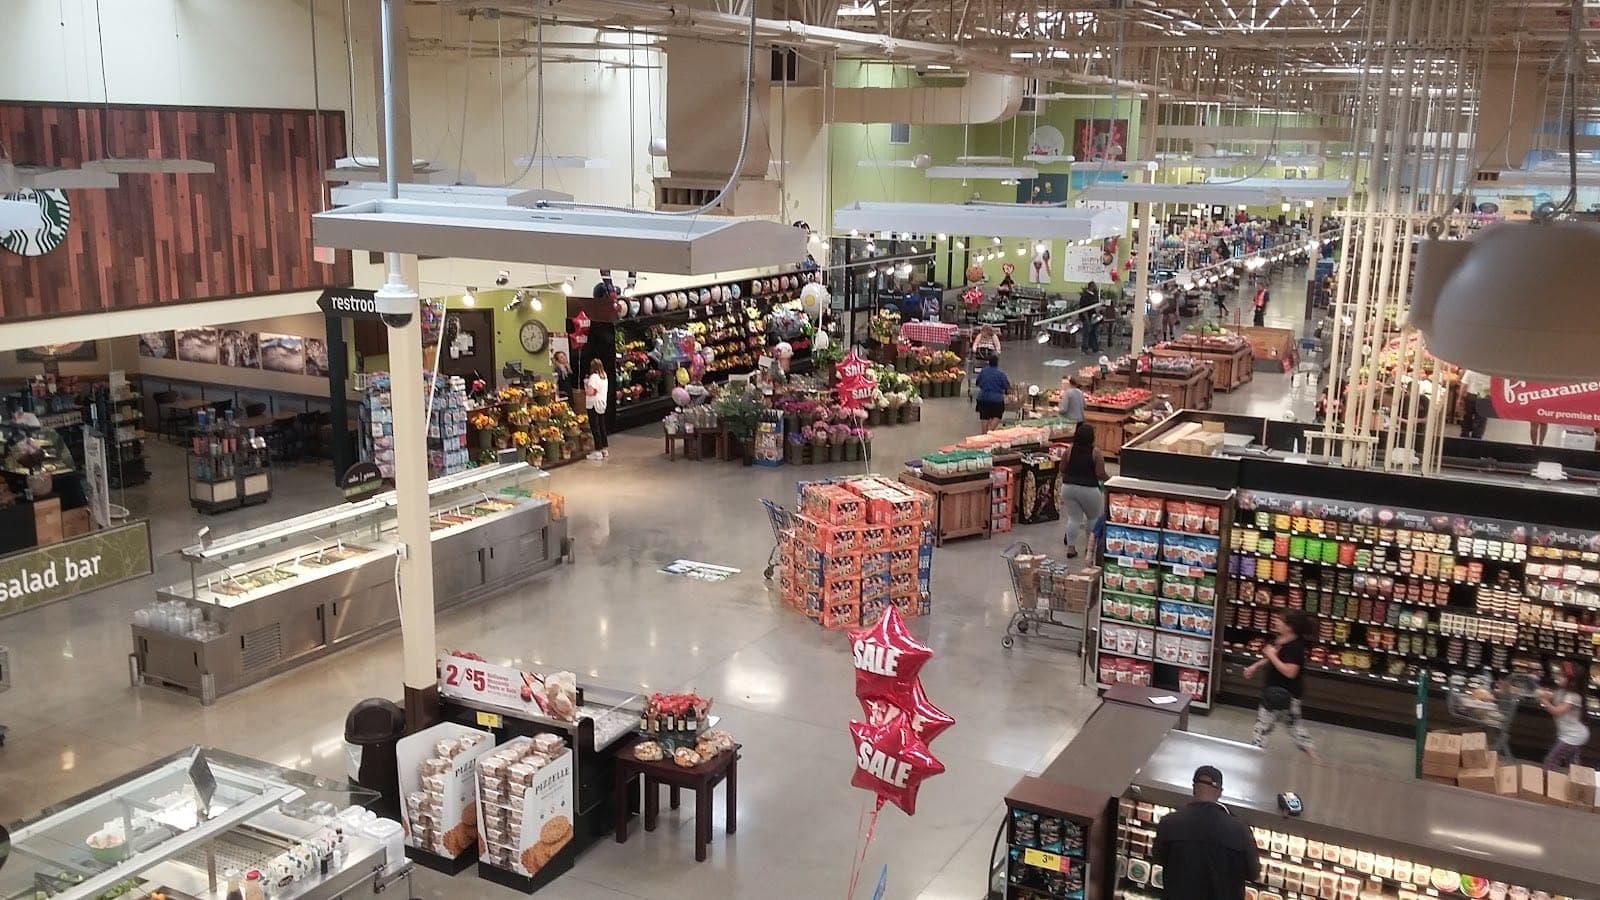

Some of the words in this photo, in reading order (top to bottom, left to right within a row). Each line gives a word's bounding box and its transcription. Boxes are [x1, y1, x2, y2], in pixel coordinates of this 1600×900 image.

[331, 295, 377, 313] restroo
[845, 362, 866, 377] SALE
[852, 386, 872, 399] SALE
[1517, 381, 1600, 405] guarante
[1537, 408, 1555, 417] Our
[1555, 411, 1593, 420] promise
[0, 561, 59, 602] salad
[65, 555, 101, 582] bar
[854, 639, 902, 678] SALE
[858, 742, 912, 789] SALE
[535, 766, 569, 795] PIZZELLE
